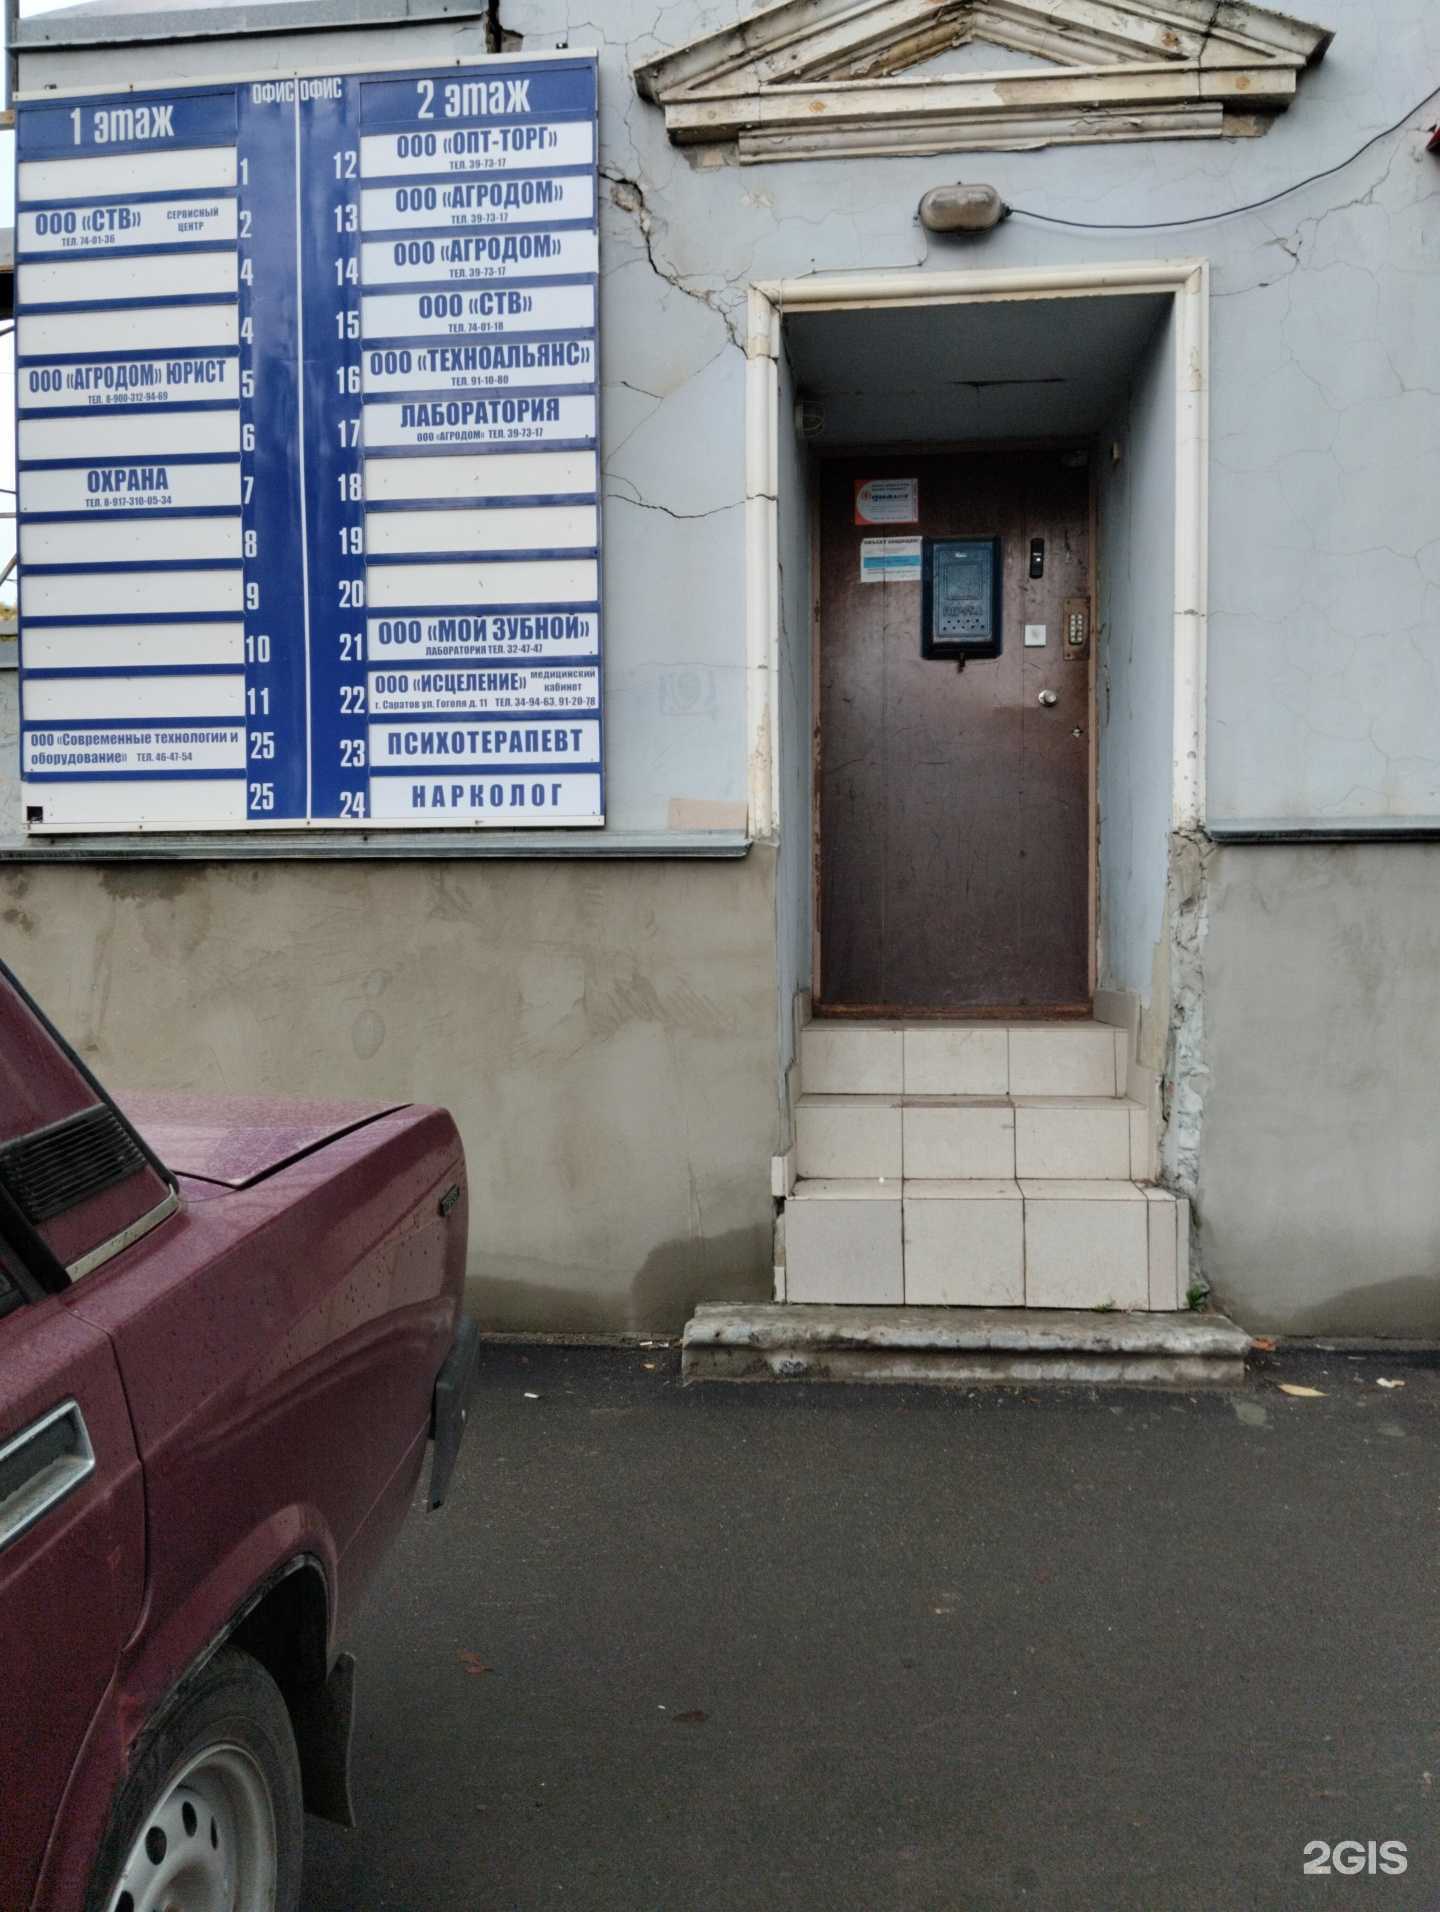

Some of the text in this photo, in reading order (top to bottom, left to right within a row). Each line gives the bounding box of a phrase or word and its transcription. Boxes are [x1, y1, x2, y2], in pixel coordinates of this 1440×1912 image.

[252, 82, 293, 104] ОФИС
[299, 78, 342, 100] ОФИС
[417, 79, 531, 119] 2 этаж
[70, 105, 174, 145] 1 этаж
[397, 127, 557, 158] ООО «ОПТ-ТОРГ»
[240, 158, 248, 185] 1
[333, 152, 357, 179] 12
[469, 157, 506, 169] 39-73-17
[396, 181, 563, 212] ООО «АГРОДОМ»
[35, 208, 141, 236] ООО «СТВ»
[167, 207, 219, 220] СЕРВИСНЫЙ
[178, 221, 204, 232] ЦЕНТР
[240, 210, 252, 239] 2
[334, 205, 358, 232] 13
[471, 212, 508, 223] 39-73-17
[394, 235, 561, 265] ООО «АГРОДОМ»
[241, 259, 253, 286] 4
[335, 259, 358, 286] 14
[469, 266, 506, 278] 39-73-17
[419, 292, 532, 319] ООО «СТВ»
[241, 317, 253, 344] 4
[336, 312, 359, 339] 15
[370, 342, 591, 374] ООО «ТЕХНОАЛЬЯНС»
[29, 359, 226, 392] ООО «АГРОДОМ» ЮРИСТ
[242, 371, 254, 398] 5
[337, 367, 360, 394] 16
[471, 374, 509, 385] 91-10-80
[401, 398, 560, 428] ЛАБОРАТОРИЯ
[242, 423, 255, 452] 6
[338, 420, 360, 447] 17
[417, 432, 434, 442] ООО
[436, 430, 485, 440] «АГРОДОМ»
[507, 428, 543, 438] 39-73-17
[88, 468, 169, 492] ОХРАНА
[244, 477, 254, 504] 7
[338, 474, 362, 501] 18
[244, 530, 257, 558] 8
[339, 528, 363, 555] 19
[247, 582, 259, 610] 9
[339, 581, 364, 608] 20
[379, 612, 589, 645] ООО «МОЙ ЗУБНОЙ»
[246, 636, 270, 663] 10
[340, 634, 363, 661] 21
[426, 644, 487, 656] ЛАБОРАТОРИЯ
[507, 644, 543, 654] 32-47-47
[376, 674, 526, 694] ООО «ИСЦЕЛЕНИЕ»
[248, 688, 269, 715] 11
[340, 686, 365, 714] 22
[383, 699, 420, 710] Саратов
[437, 698, 467, 709] Гоголя
[480, 697, 488, 707] 11
[31, 731, 238, 747] ООО «Современные технологии и
[251, 732, 274, 759] 25
[388, 729, 583, 755] ПСИХОТЕРАПЕВТ
[31, 752, 128, 766] оборудование»
[155, 752, 192, 762] 46-47-54
[340, 740, 365, 767] 23
[250, 783, 274, 810] 25
[340, 792, 365, 818] 24
[412, 783, 562, 808] НАРКОЛОГ
